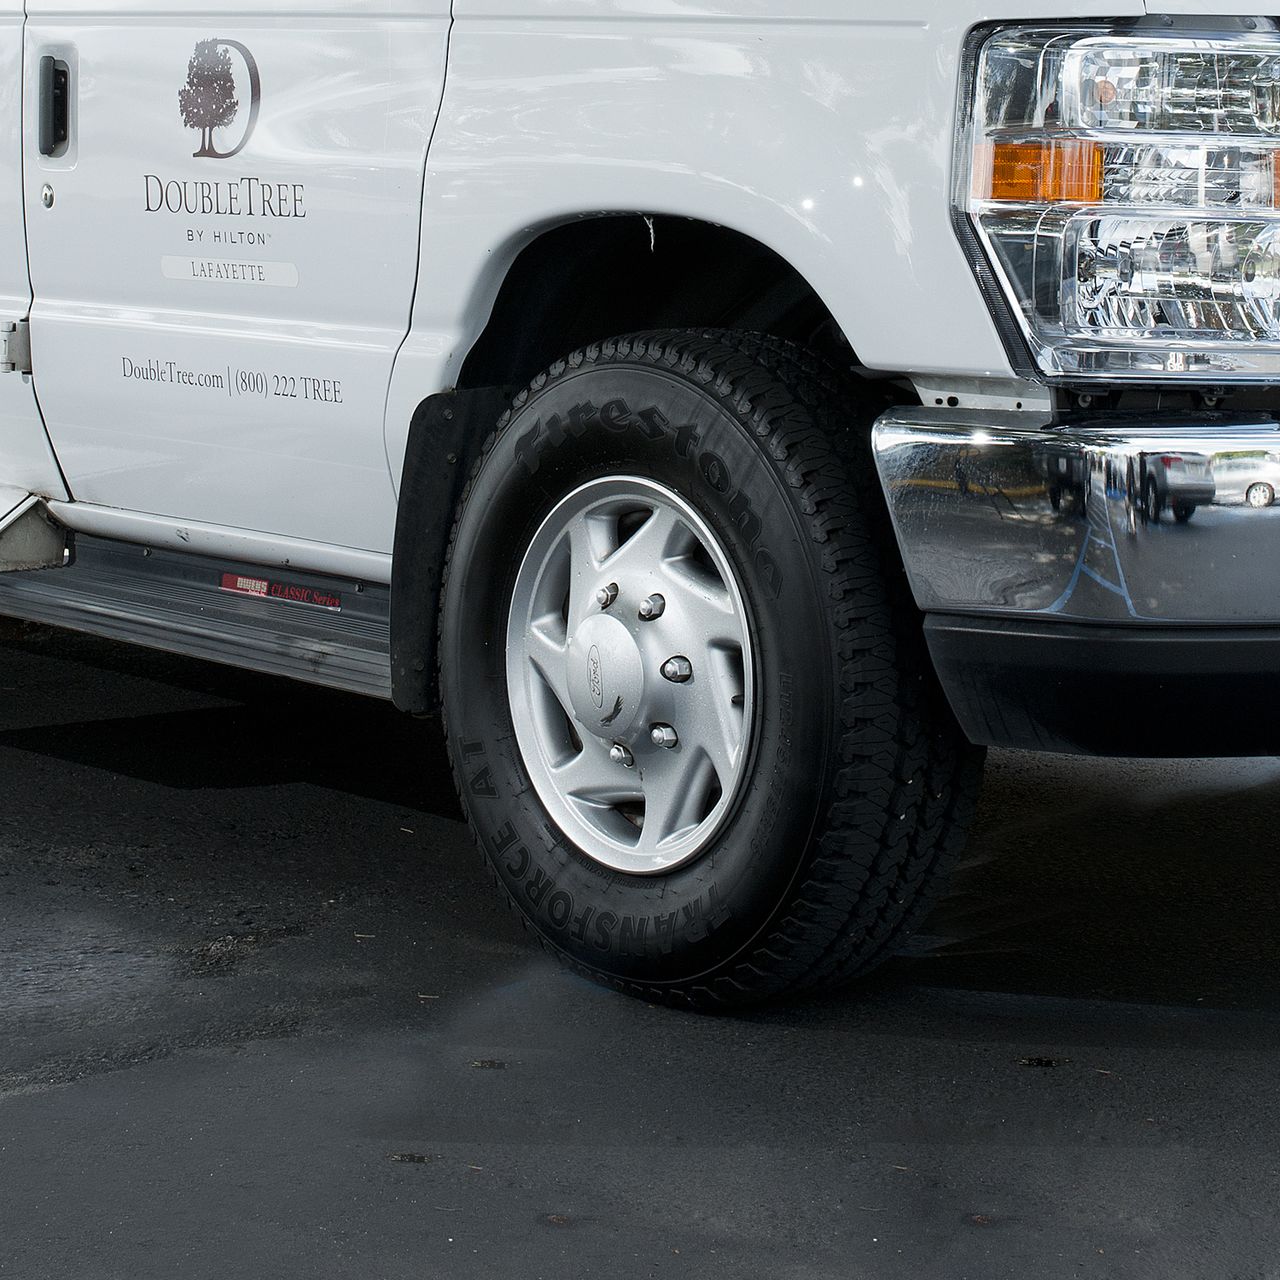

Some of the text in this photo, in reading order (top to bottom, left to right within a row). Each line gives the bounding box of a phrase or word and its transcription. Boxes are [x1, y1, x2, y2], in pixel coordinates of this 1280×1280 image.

[186, 229, 266, 245] BY HILTON
[191, 261, 266, 282] LAFAYETTE
[121, 356, 344, 404] DoubleTree.com (800) 222 TREE
[514, 396, 784, 601] Firestone
[270, 583, 312, 602] CLASSIC
[312, 590, 342, 607] Series
[459, 736, 500, 799] AT
[490, 819, 735, 956] TRANSFORCE
